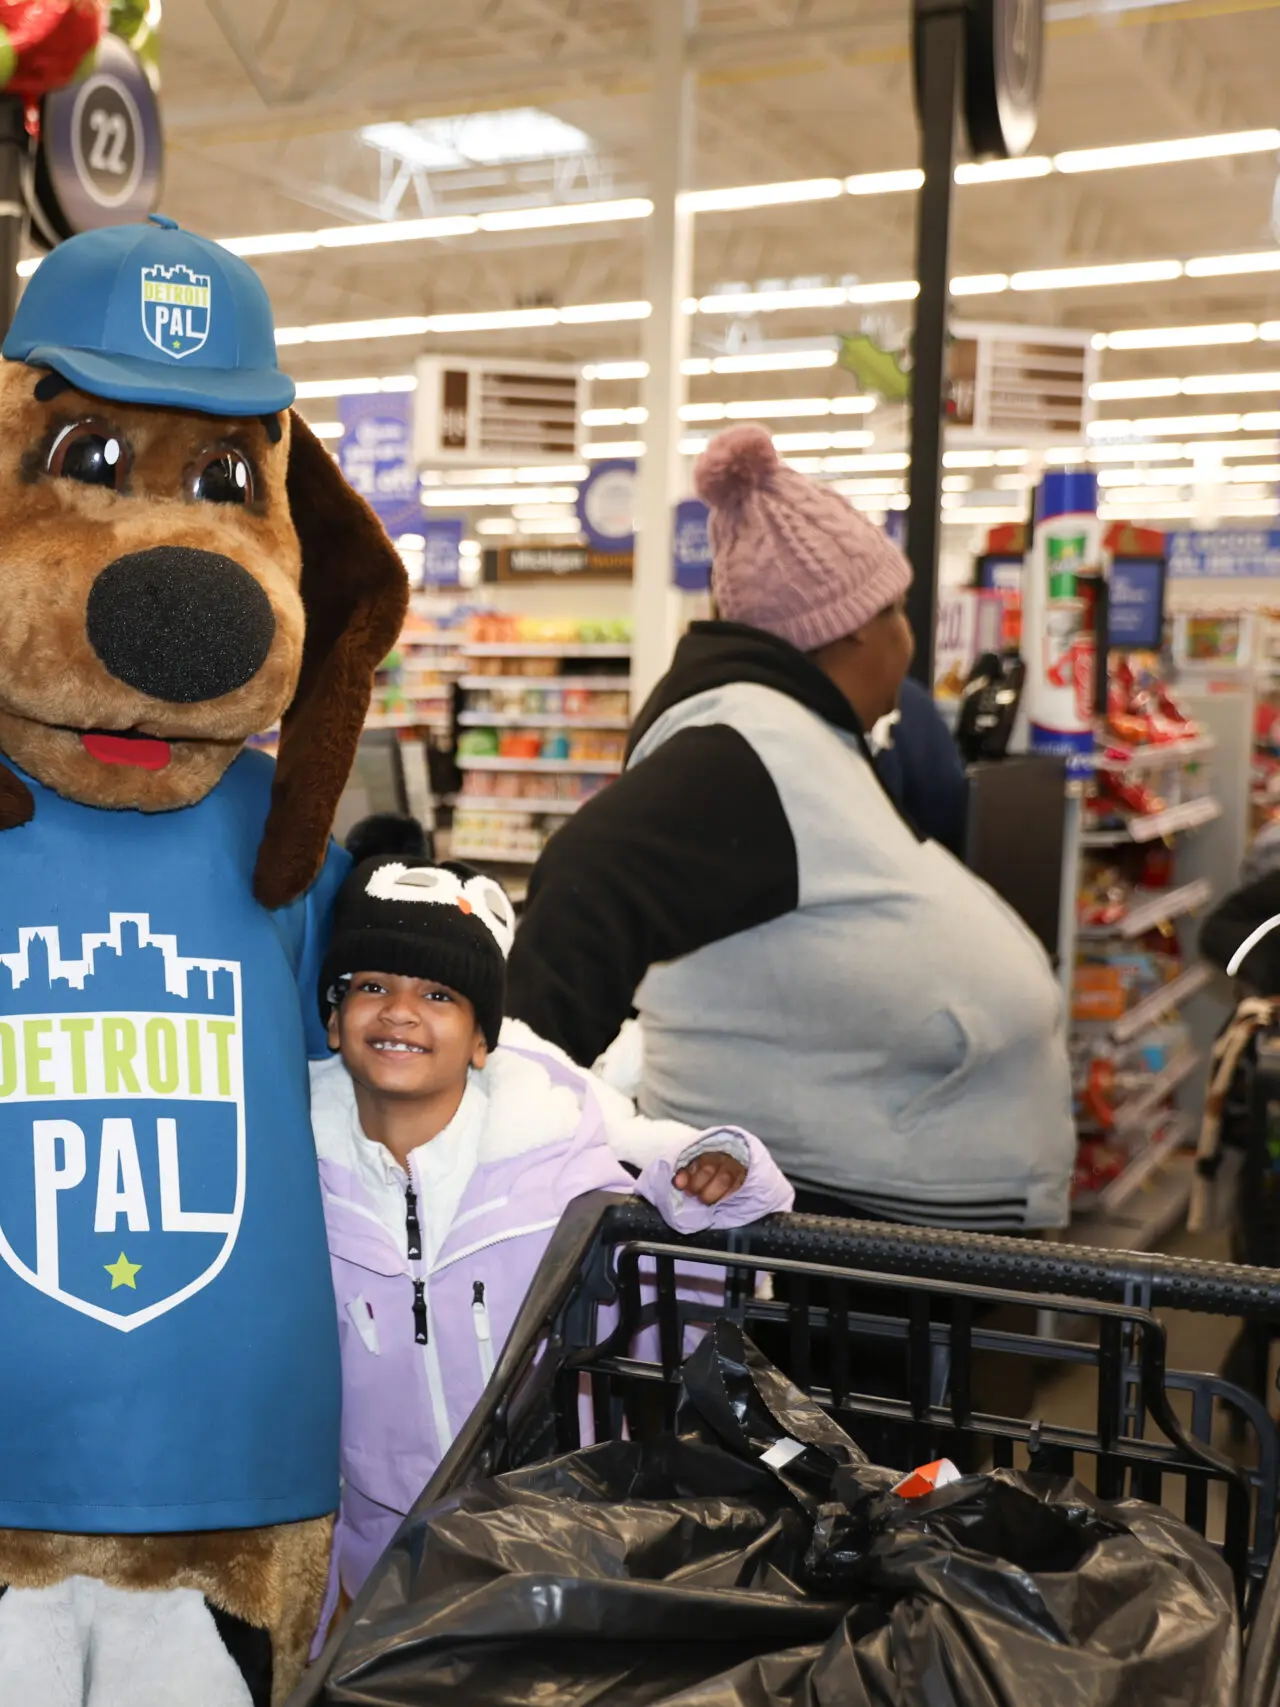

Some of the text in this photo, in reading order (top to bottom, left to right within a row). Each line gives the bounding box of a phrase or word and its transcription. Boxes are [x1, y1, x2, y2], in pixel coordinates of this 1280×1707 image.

[90, 109, 127, 174] 22
[144, 281, 209, 307] DETROIT
[155, 306, 206, 343] PAL
[32, 1117, 234, 1276] PAL
